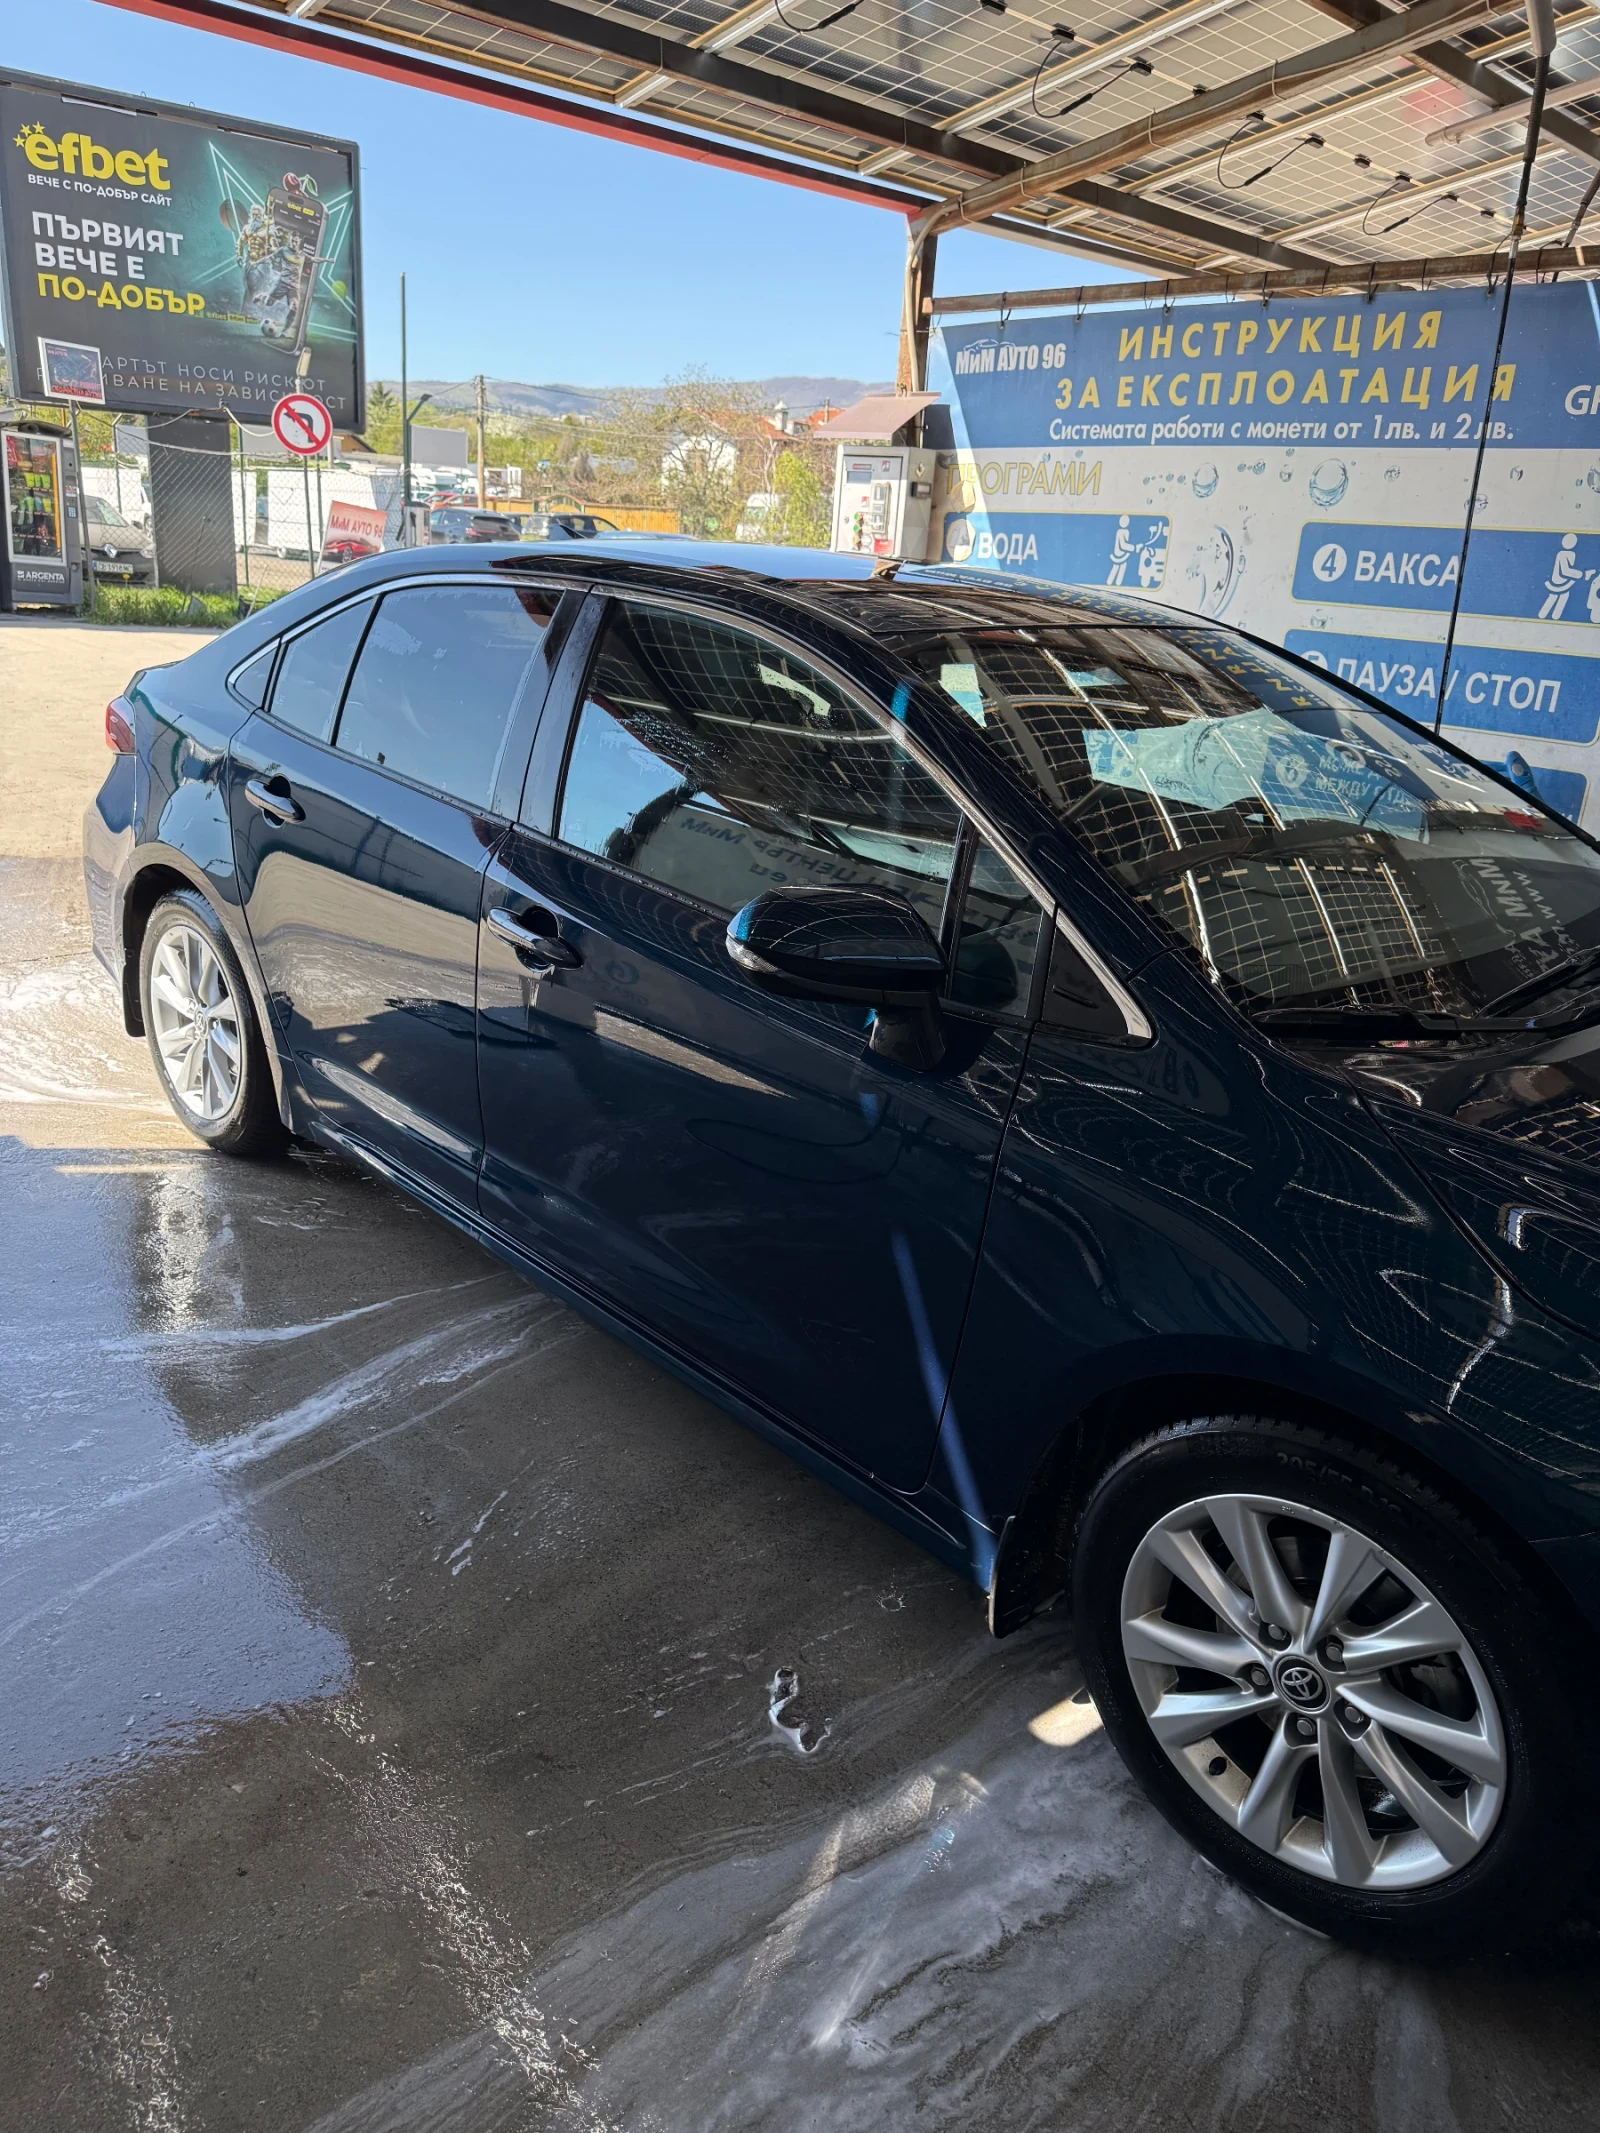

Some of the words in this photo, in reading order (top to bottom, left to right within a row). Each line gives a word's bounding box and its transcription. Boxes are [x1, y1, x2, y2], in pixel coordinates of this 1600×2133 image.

[24, 132, 171, 190] efbet
[28, 173, 60, 189] ВЕЧЕ
[63, 180, 72, 190] С
[74, 181, 139, 201] ПО-ДОБЪР
[141, 193, 172, 207] САЙТ
[32, 211, 184, 256] ПЪРВИЯТ
[35, 242, 118, 277] ВЕЧЕ
[127, 255, 146, 280] Е
[38, 272, 206, 316] ПО-ДОБЪР
[1118, 311, 1442, 361] ИНСТРУКЦИЯ
[102, 356, 167, 375] АРТЪТ
[178, 363, 235, 382] НОСИ
[244, 371, 295, 388] РИСК
[303, 378, 326, 391] ОТ
[955, 348, 995, 375] МиМ
[997, 344, 1039, 371] АУТО
[1042, 343, 1067, 369] 96
[37, 367, 169, 391] РИВАНЕ
[179, 381, 206, 395] НА
[215, 383, 346, 409] ЗАВИССТ
[1055, 377, 1101, 410] ЗА
[1116, 364, 1517, 410] ЕКСПЛОАТАЦИЯ
[1049, 418, 1147, 440] Системата
[1151, 414, 1225, 445] работи
[1230, 422, 1242, 440] с
[1246, 421, 1327, 440] монети
[1333, 422, 1362, 440] от
[1429, 422, 1446, 440] и
[947, 460, 1103, 496] ПРОГРАМИ
[330, 515, 350, 531] МиМ
[351, 521, 372, 535] АУТО
[374, 525, 383, 538] 96
[977, 531, 1039, 566] ВОДА
[25, 571, 65, 581] ARGENTA
[1321, 548, 1338, 579] 4
[1354, 550, 1461, 588] ВАКСА
[1336, 658, 1437, 698] ПАУЗА
[1444, 670, 1459, 700] /
[1465, 672, 1561, 713] СТОП
